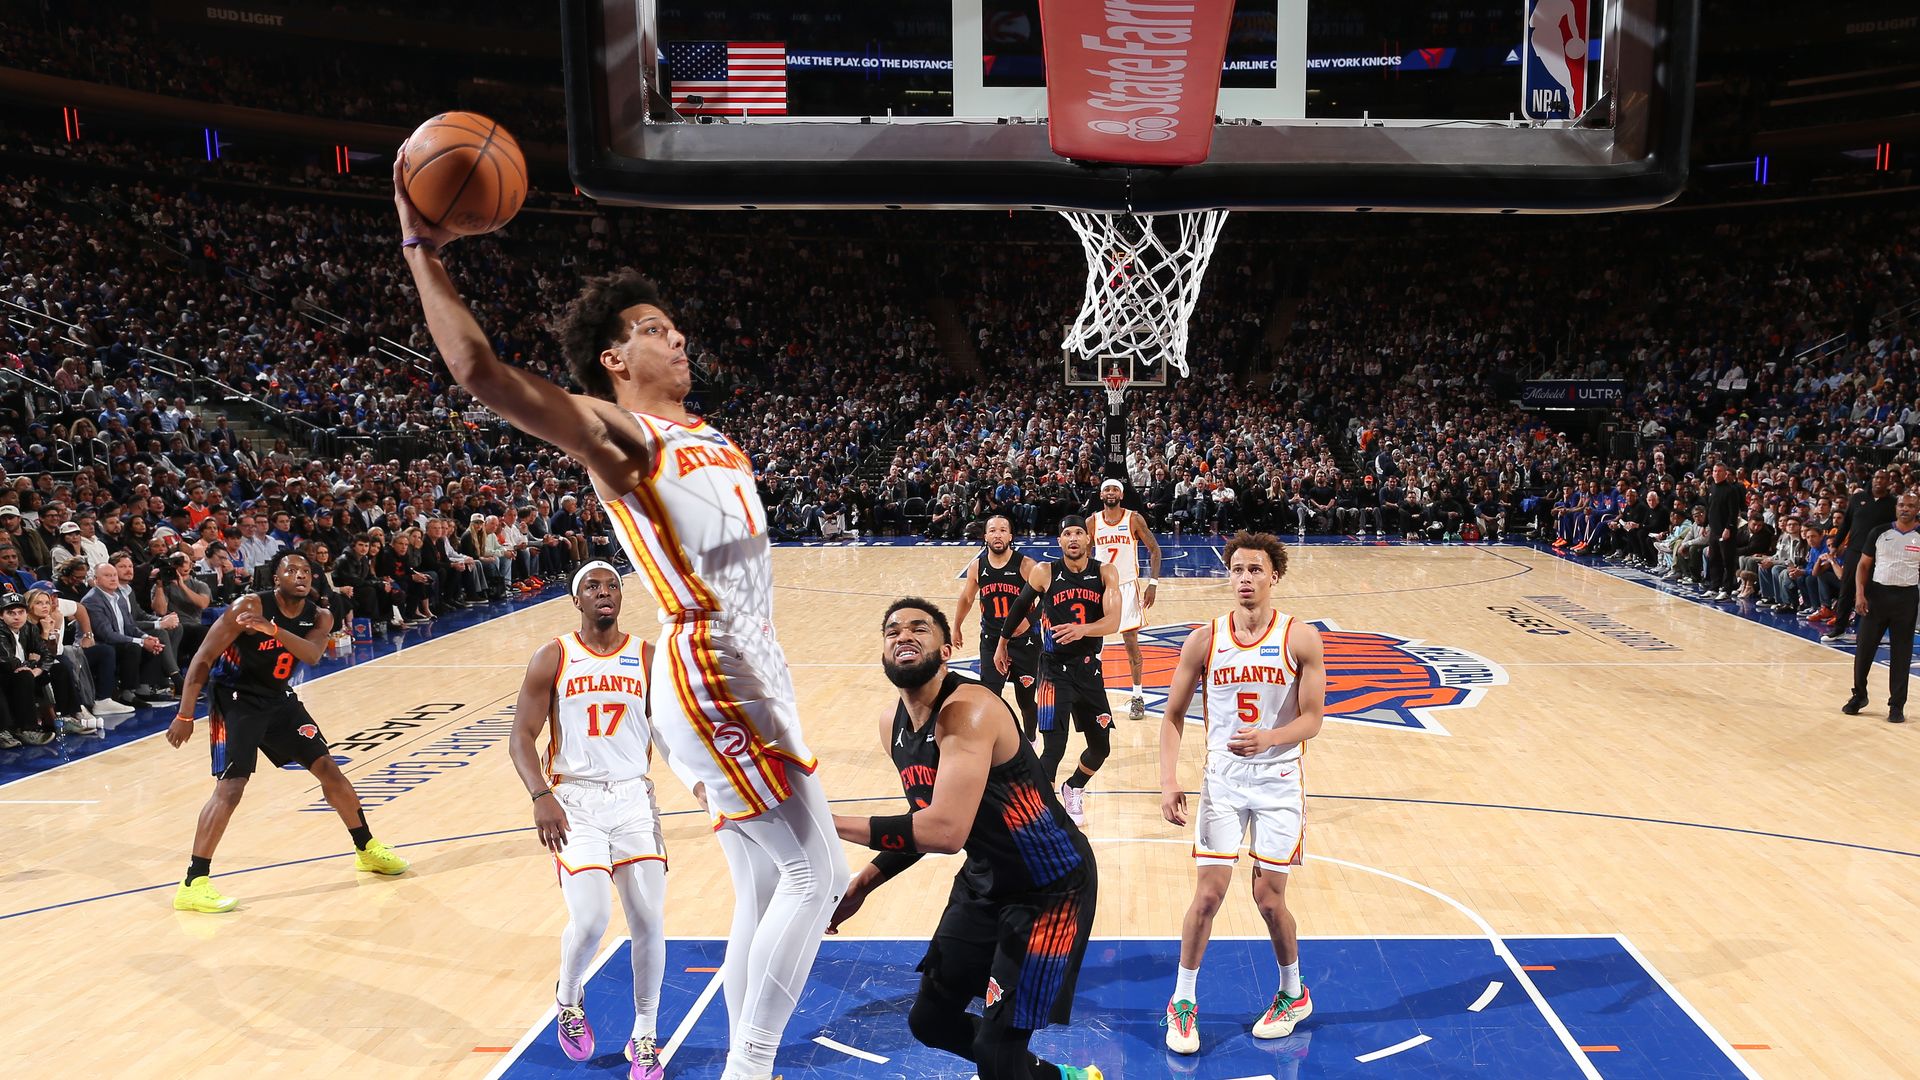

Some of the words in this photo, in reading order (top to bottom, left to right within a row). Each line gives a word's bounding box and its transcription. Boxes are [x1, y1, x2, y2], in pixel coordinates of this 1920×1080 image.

[206, 7, 239, 21] BUD
[240, 11, 284, 27] LIGHT
[812, 56, 833, 66] THE
[834, 57, 861, 67] PLAY.
[861, 58, 880, 68] GO
[880, 59, 901, 68] THE
[902, 60, 954, 70] DISTANCE
[1230, 60, 1269, 70] AIRLINE
[1306, 59, 1331, 68] NEW
[1331, 58, 1360, 68] YORK
[1361, 56, 1402, 66] KNICKS
[1578, 388, 1623, 399] ULTRA
[1110, 434, 1121, 444] GET
[1110, 444, 1121, 452] THE
[1113, 453, 1124, 464] App
[734, 484, 758, 538] 1
[1096, 534, 1130, 546] ATLANTA
[1108, 548, 1118, 564] 7
[981, 583, 997, 596] NEW
[996, 583, 1020, 596] YORK
[1053, 588, 1076, 606] NEW
[1076, 588, 1101, 604] YORK
[993, 596, 1009, 618] 11
[1070, 603, 1086, 625] 3
[273, 652, 294, 680] 8
[1213, 666, 1286, 686] ATLANTA
[566, 674, 643, 698] ATLANTA
[1236, 692, 1260, 724] 5
[587, 703, 627, 736] 17
